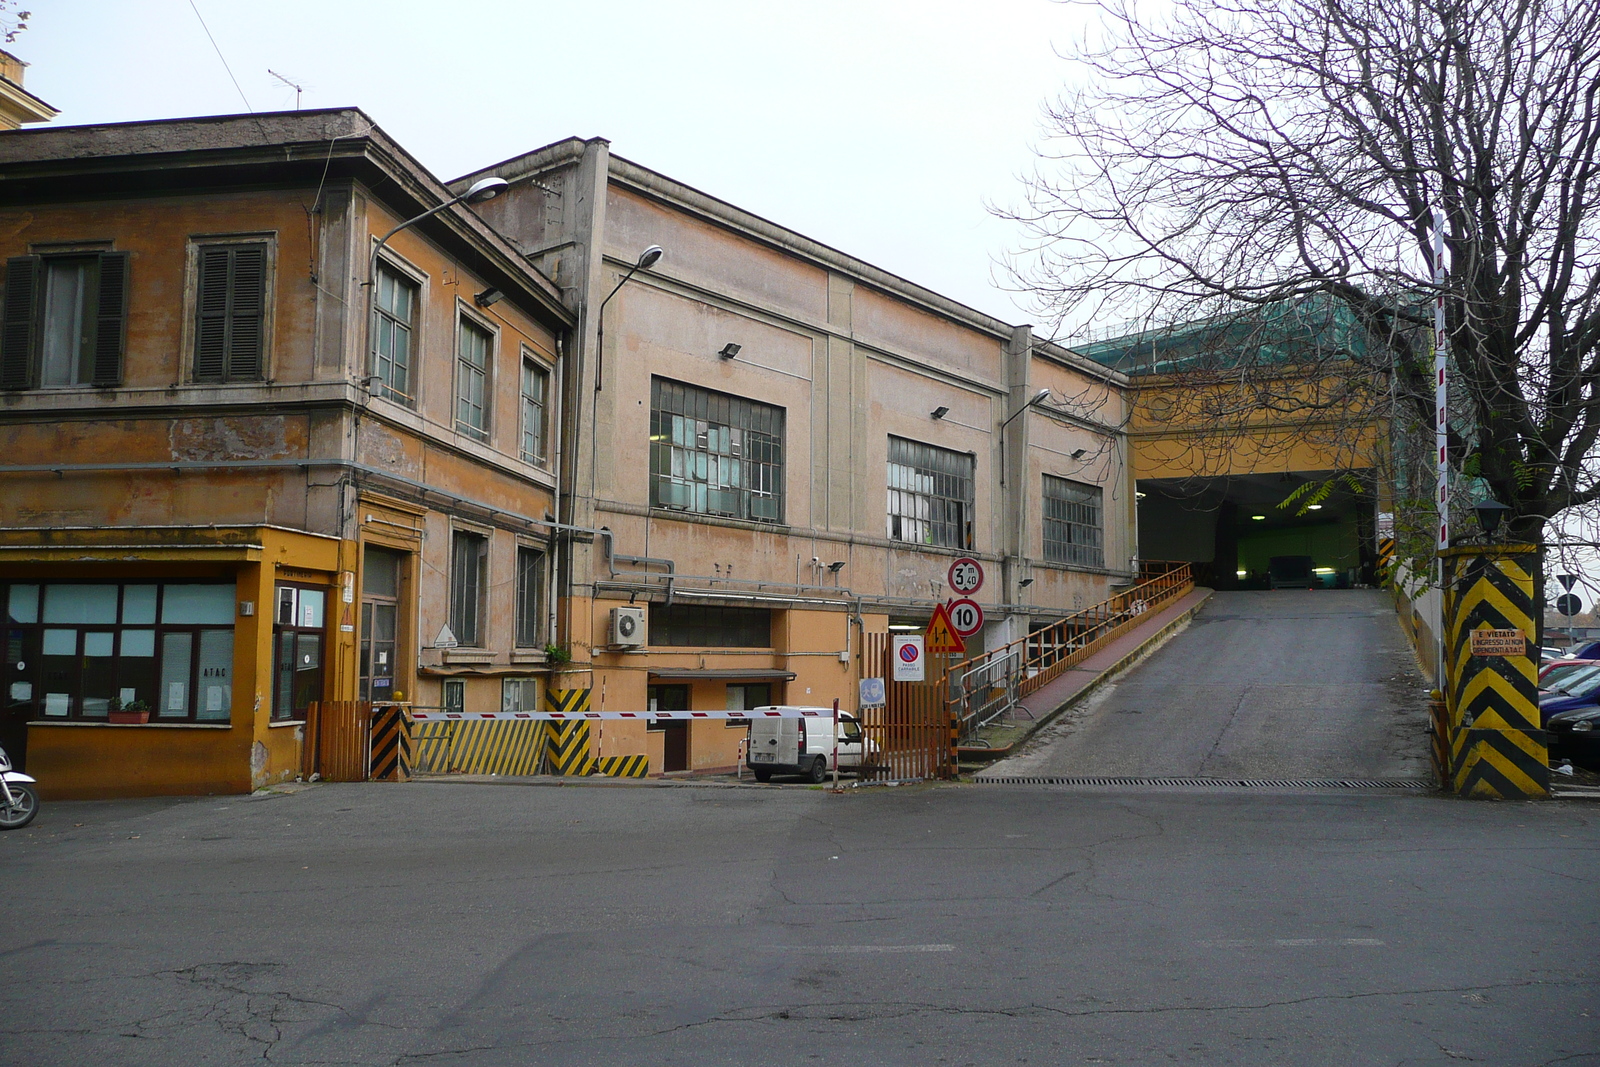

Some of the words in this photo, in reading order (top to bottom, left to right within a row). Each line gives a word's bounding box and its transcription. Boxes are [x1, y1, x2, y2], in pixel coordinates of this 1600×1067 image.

[956, 568, 964, 585] 3
[967, 575, 977, 585] 40
[956, 609, 973, 626] 10
[204, 668, 225, 677] ATAC
